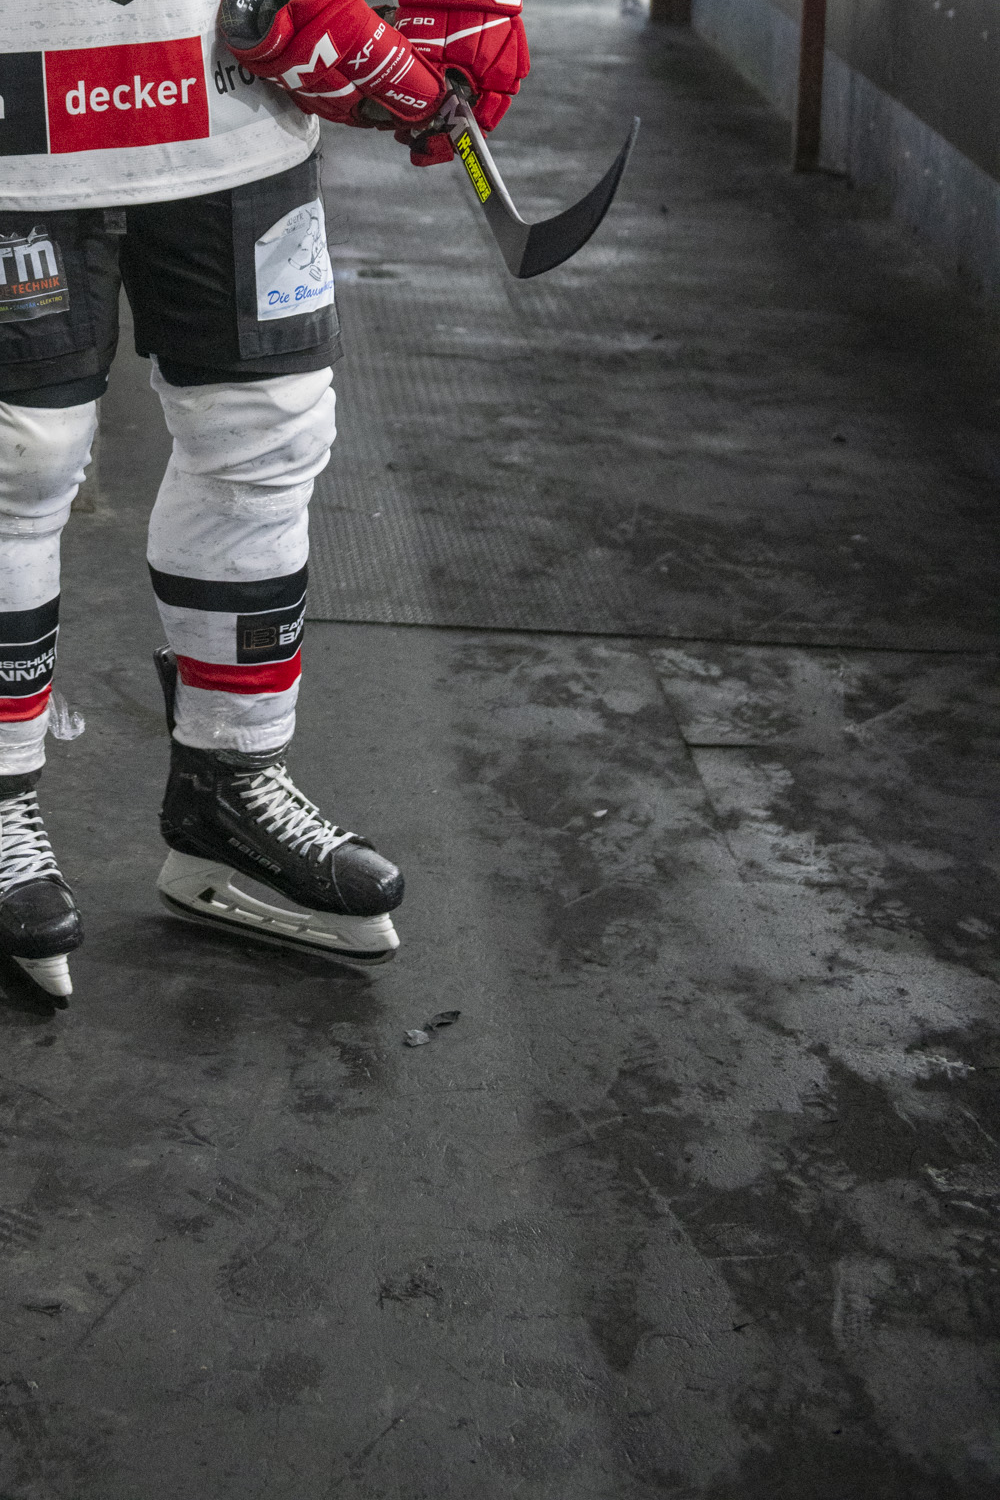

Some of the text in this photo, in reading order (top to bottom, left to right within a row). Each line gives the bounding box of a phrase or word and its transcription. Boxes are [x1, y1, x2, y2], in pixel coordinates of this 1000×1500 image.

[412, 17, 435, 26] 80
[347, 22, 387, 71] XF 80
[65, 74, 197, 116] decker
[385, 89, 428, 110] CCM
[267, 290, 290, 306] Die
